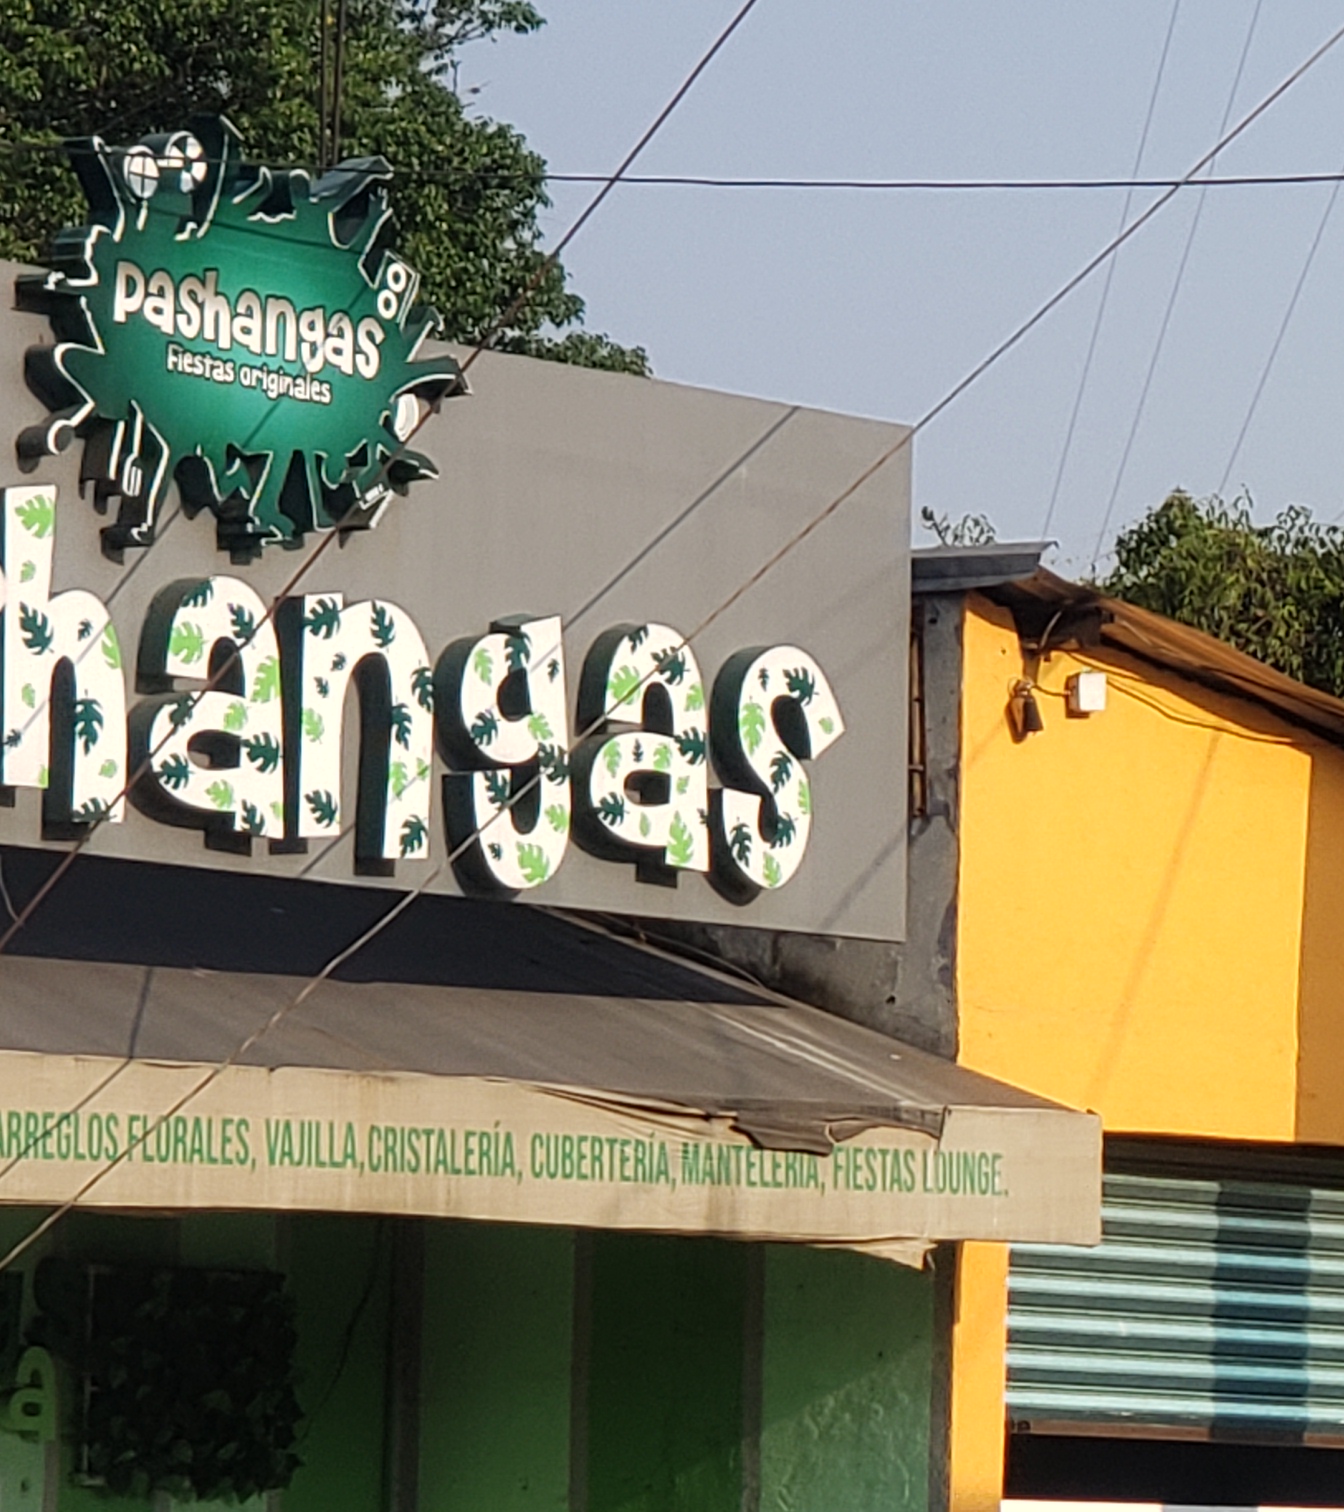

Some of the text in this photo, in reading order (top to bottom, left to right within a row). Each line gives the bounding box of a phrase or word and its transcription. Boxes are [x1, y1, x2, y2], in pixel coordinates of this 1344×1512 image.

[166, 342, 333, 406] Fiestas originales
[0, 484, 846, 890] hangas
[127, 1115, 257, 1176] FLORALES,
[264, 1117, 366, 1176] VAJILLA,
[368, 1120, 524, 1185] CRISTALERÍA,
[530, 1131, 678, 1192] CUBERTERÍA,
[832, 1147, 916, 1193] FIESTAS
